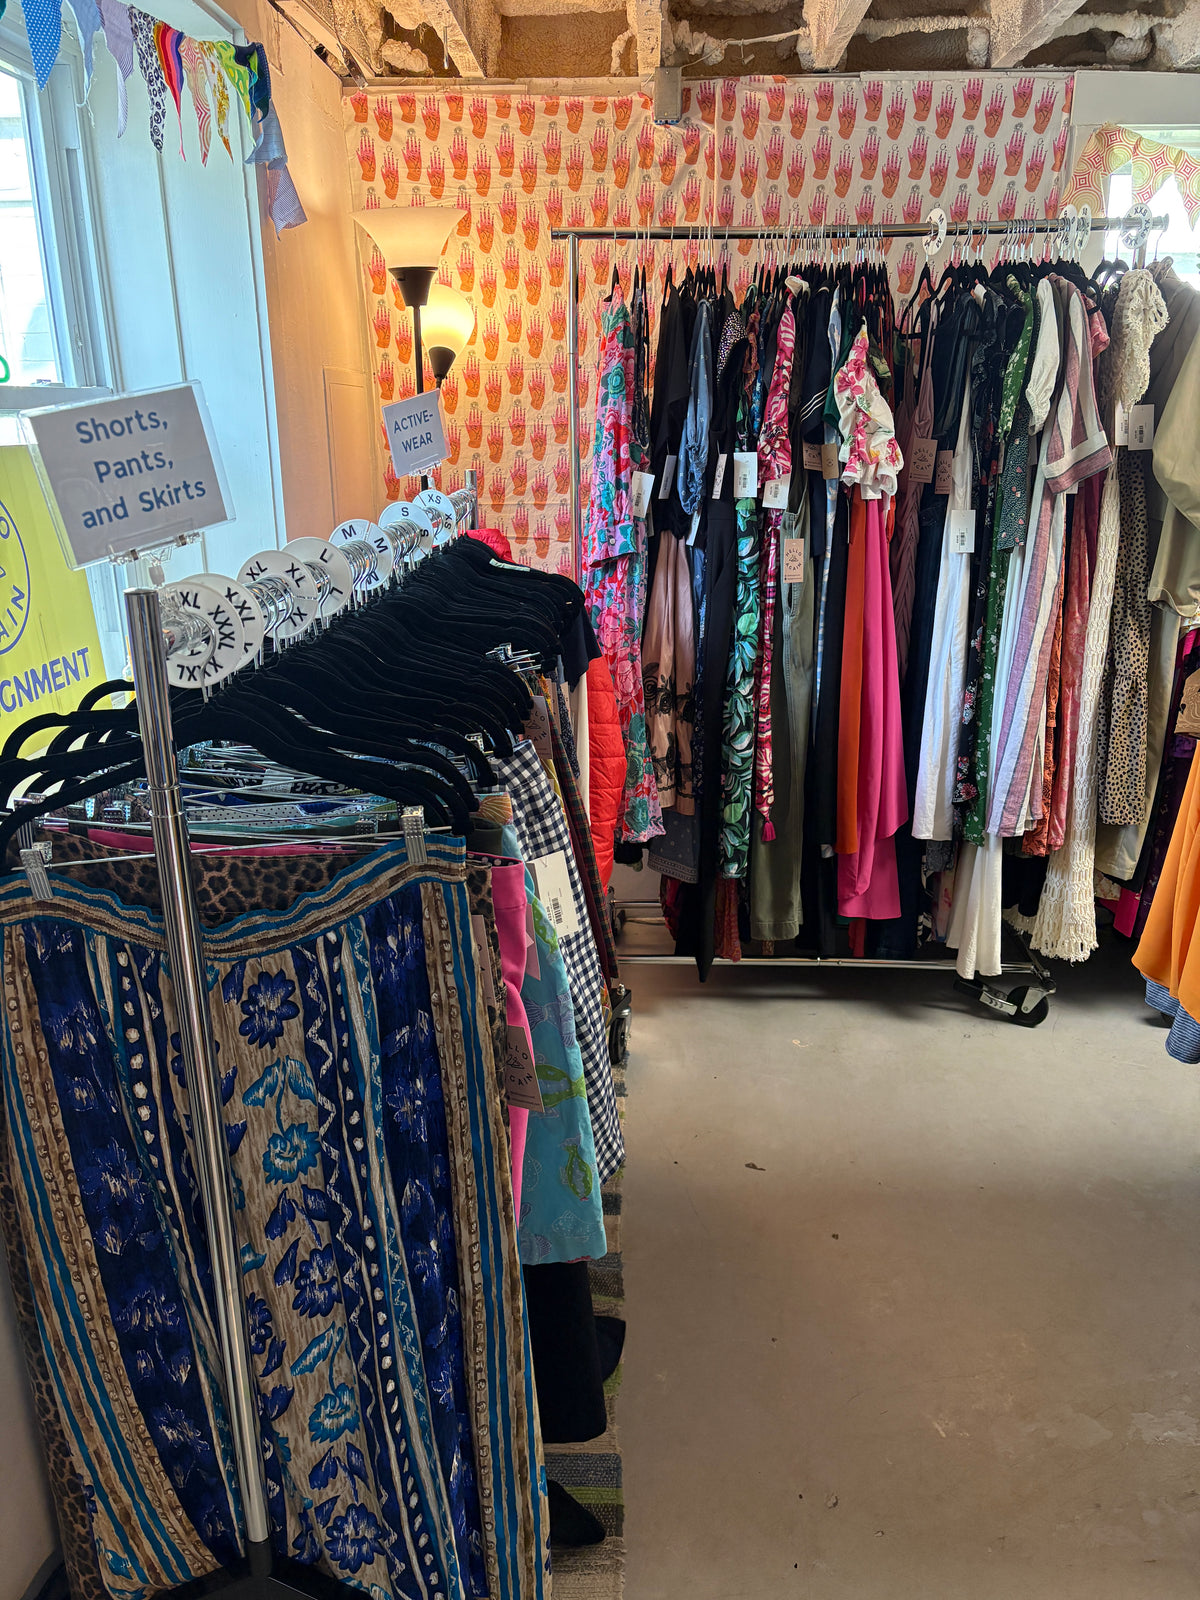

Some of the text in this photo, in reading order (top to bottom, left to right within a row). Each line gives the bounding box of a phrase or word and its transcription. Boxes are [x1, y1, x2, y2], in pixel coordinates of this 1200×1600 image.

[75, 409, 168, 444] Shorts,
[393, 409, 433, 434] ACTIVE-
[401, 431, 433, 453] WEAR
[94, 450, 174, 483] Pants,
[81, 480, 207, 529] and Skirts
[427, 493, 442, 505] XS
[401, 507, 410, 517] S
[444, 513, 453, 530] XS
[341, 524, 357, 540] M
[374, 537, 389, 553] M
[785, 548, 802, 557] HELLO
[319, 548, 328, 564] L
[246, 561, 268, 581] XL
[285, 562, 306, 588] XL
[329, 586, 344, 596] L
[225, 587, 256, 627] XXL
[207, 605, 236, 650] XXXL
